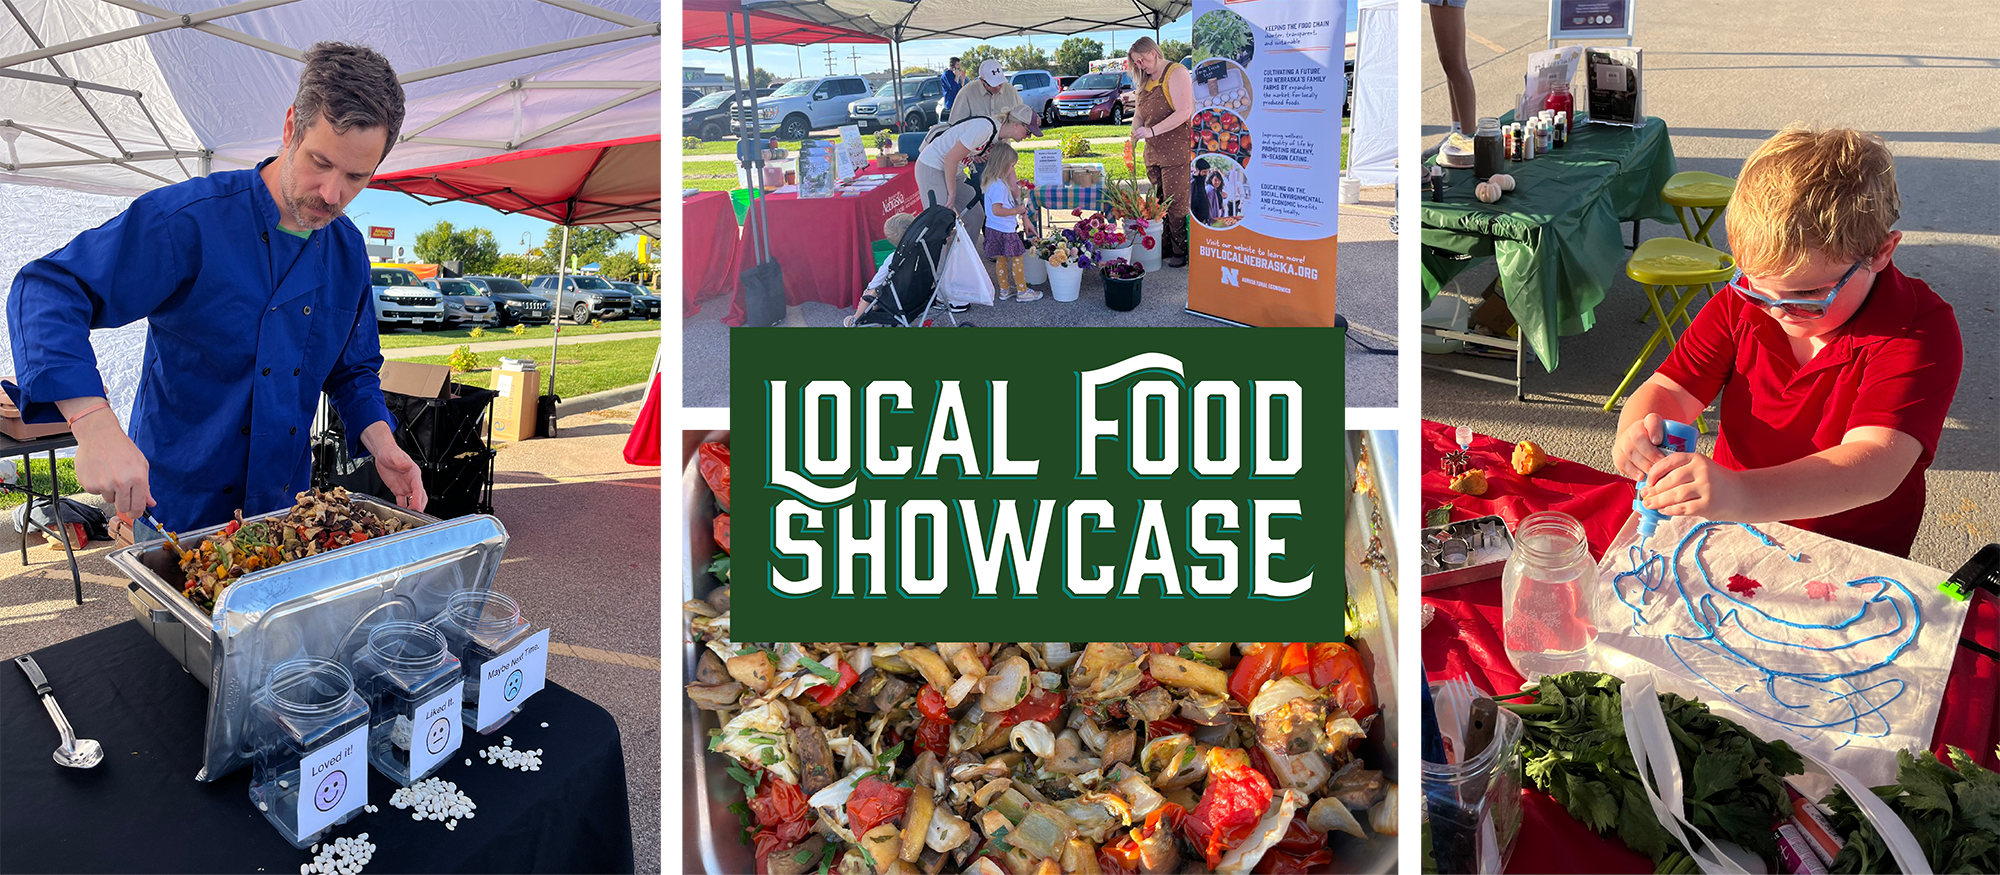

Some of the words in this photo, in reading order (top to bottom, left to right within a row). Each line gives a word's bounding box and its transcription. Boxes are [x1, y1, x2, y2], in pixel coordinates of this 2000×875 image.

[1262, 131, 1283, 139] Improving
[1307, 141, 1314, 149] by
[1261, 183, 1286, 191] EDUCATING
[1261, 190, 1279, 198] SOCIAL,
[1268, 206, 1282, 214] eating
[1272, 199, 1296, 207] ECONOMIC
[1297, 202, 1318, 210] benefits
[1206, 238, 1220, 247] Visit
[1233, 243, 1256, 254] website
[1258, 247, 1265, 256] to
[1267, 249, 1284, 259] learn
[1286, 255, 1306, 265] more!
[1199, 245, 1318, 280] BUYLOCALNEBRASKA.ORG
[1221, 266, 1240, 287] N
[488, 663, 510, 680] Maybe
[511, 652, 524, 667] Next
[525, 644, 539, 656] Time.
[426, 702, 447, 720] Liked
[311, 751, 342, 777] Loved
[344, 744, 353, 757] it!
